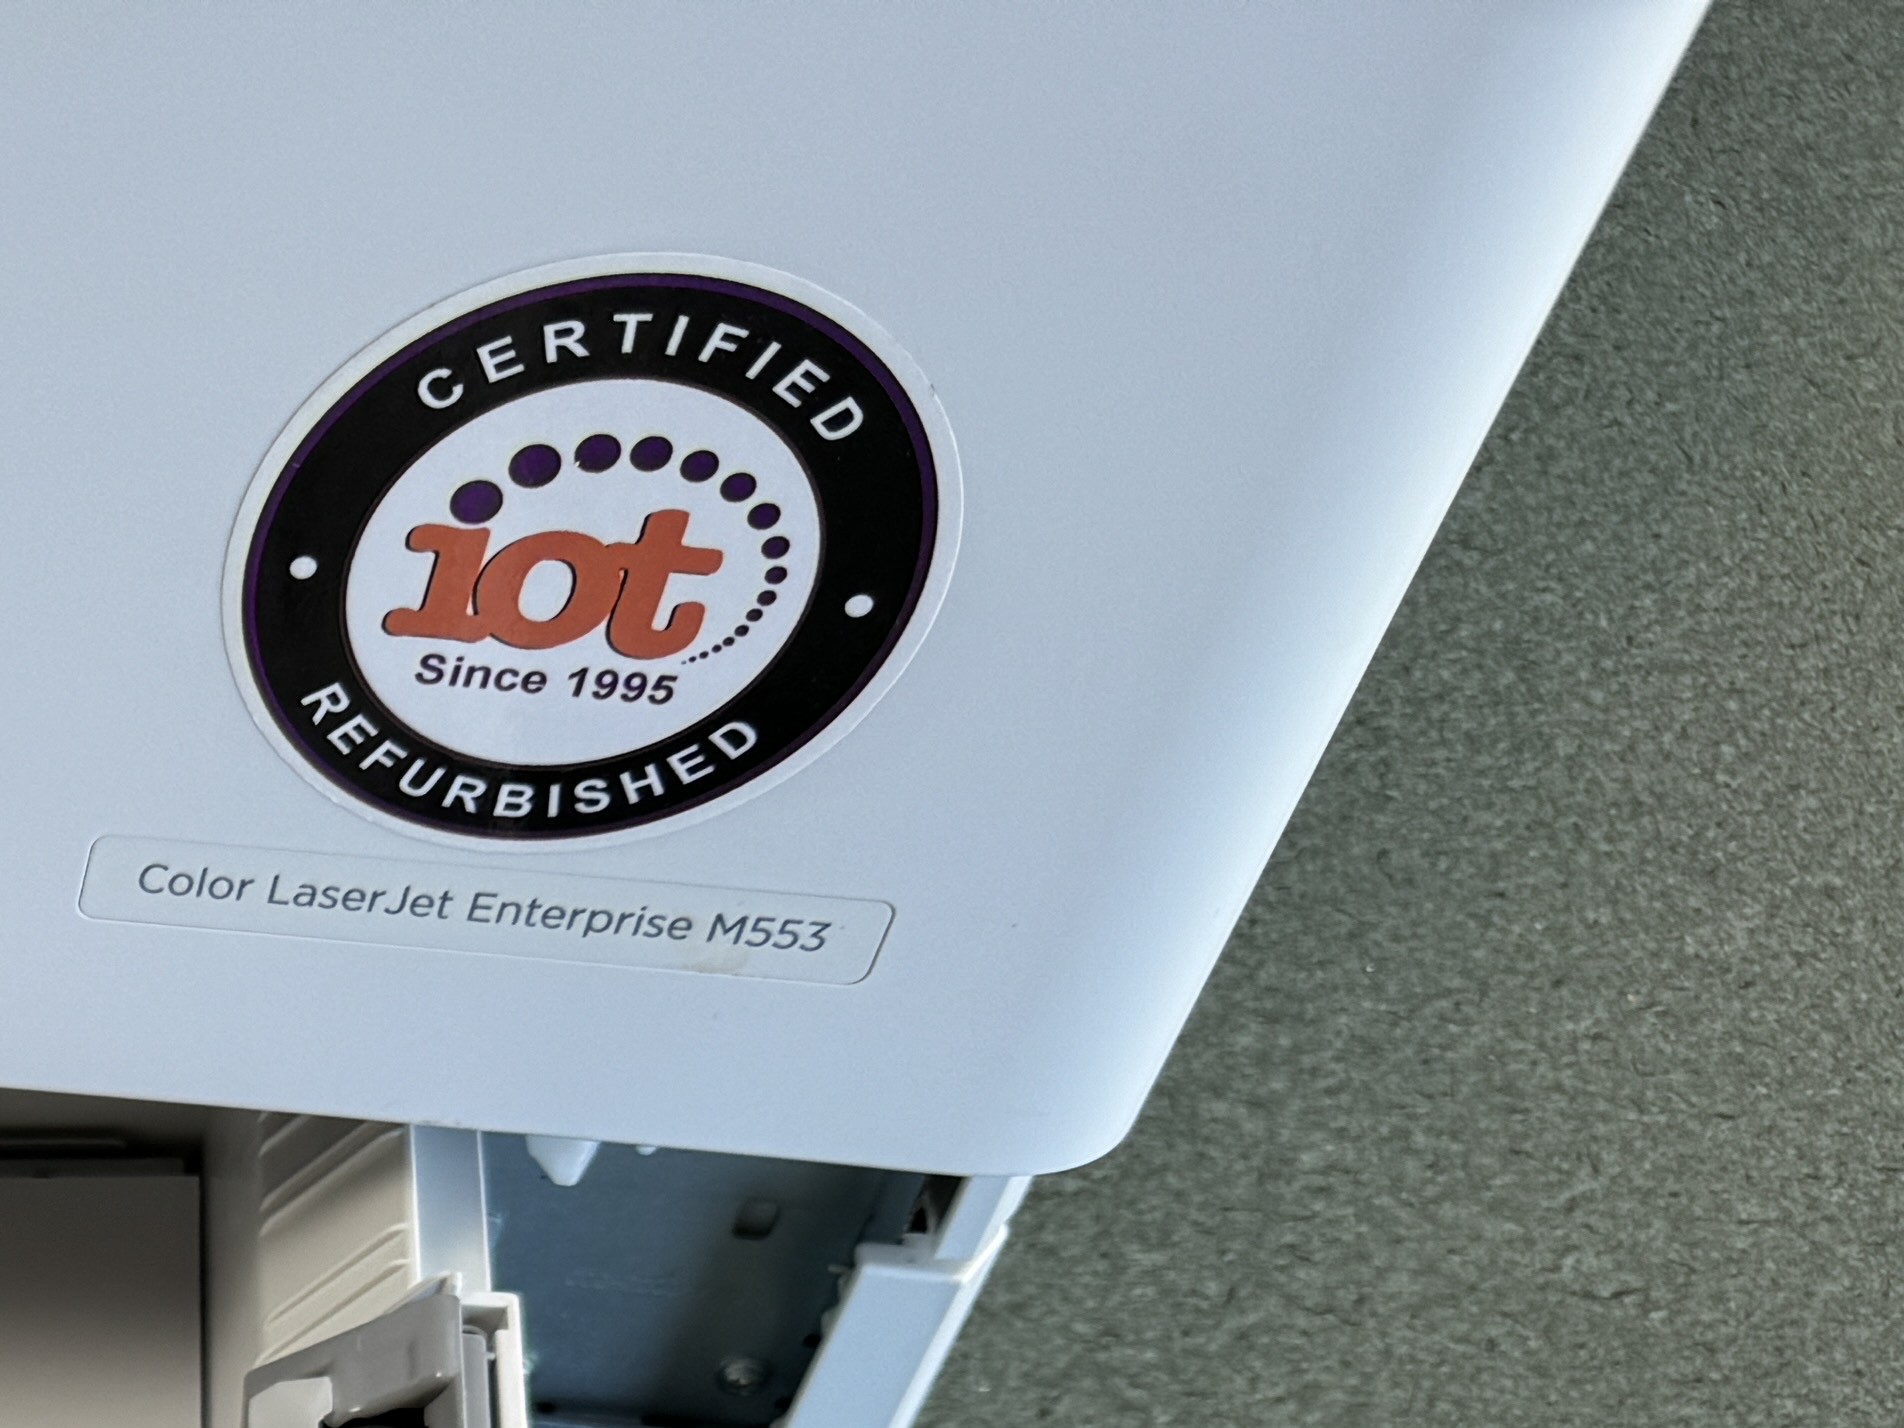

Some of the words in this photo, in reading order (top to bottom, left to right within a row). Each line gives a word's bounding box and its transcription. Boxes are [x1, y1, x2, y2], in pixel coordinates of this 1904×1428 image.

[416, 311, 866, 443] CERTIFIED
[381, 479, 724, 661] iot
[414, 652, 548, 697] Since
[566, 664, 679, 706] 1995
[300, 682, 760, 819] REFURBISHED
[137, 861, 254, 903] Color
[266, 873, 453, 920] LaserJet
[466, 890, 693, 942] Enterprise
[706, 910, 832, 953] M553
